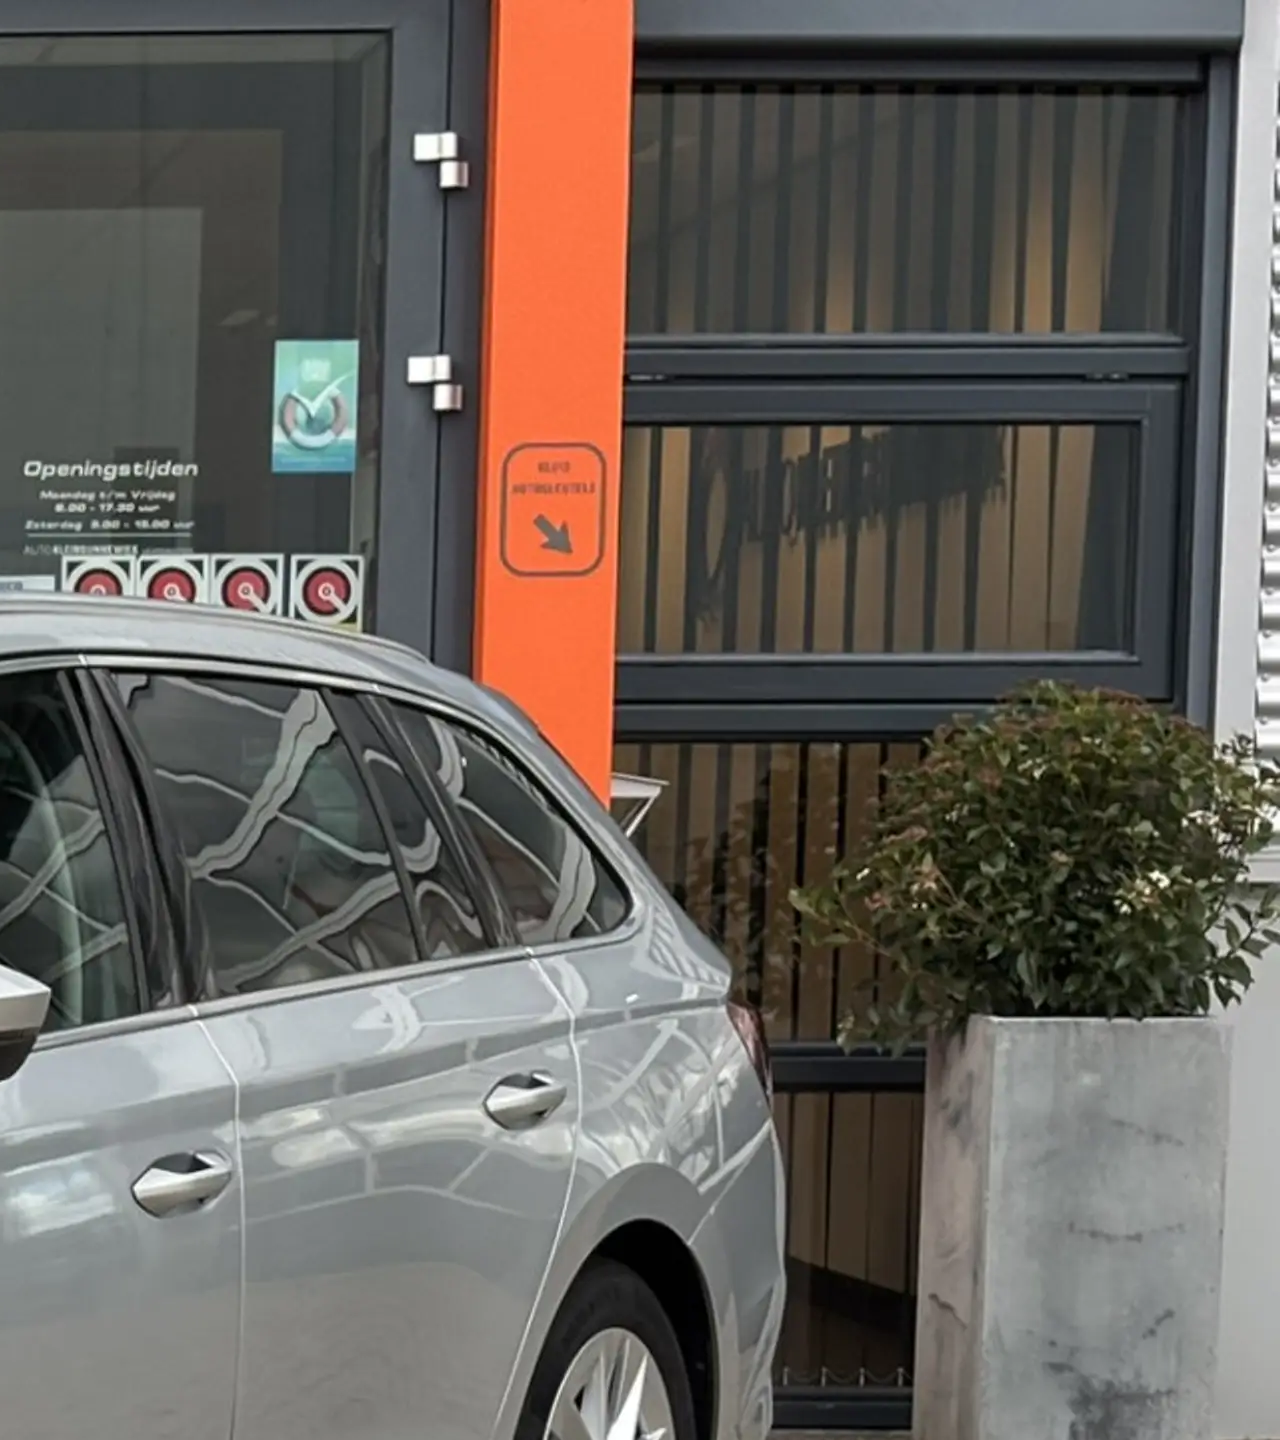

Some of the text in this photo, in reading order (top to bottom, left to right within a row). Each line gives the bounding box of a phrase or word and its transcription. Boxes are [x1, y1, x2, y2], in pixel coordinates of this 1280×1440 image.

[23, 458, 199, 482] Openingstijden
[38, 489, 96, 502] Maandag
[130, 489, 176, 502] Vrijdag
[138, 504, 160, 513] uur
[24, 519, 83, 532] Zaterdag
